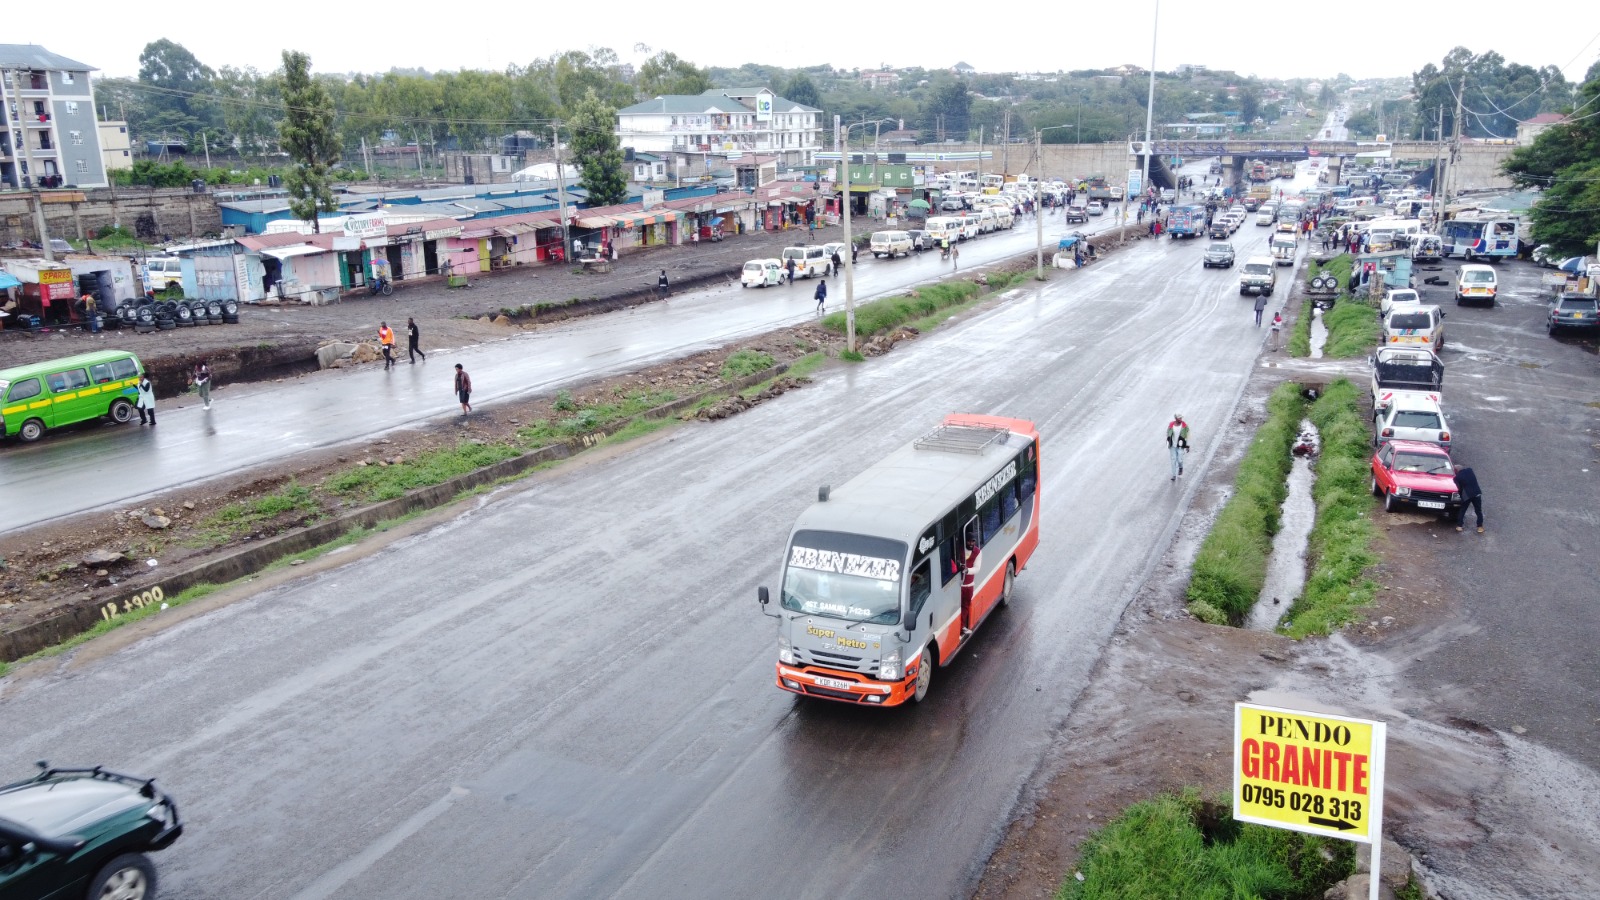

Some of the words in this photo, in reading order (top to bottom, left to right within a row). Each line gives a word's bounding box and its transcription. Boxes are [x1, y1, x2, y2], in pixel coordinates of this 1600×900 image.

[43, 271, 71, 280] SPARES
[975, 460, 1017, 510] EBENEZER
[788, 545, 901, 581] EBENEZER
[819, 602, 846, 612] SAMUEL
[807, 625, 835, 639] Super
[836, 636, 867, 650] Metro
[1258, 714, 1351, 746] PENDO
[1242, 737, 1368, 795] GRANITE
[1242, 783, 1285, 808] 0795
[1290, 791, 1324, 815] 028
[1329, 797, 1362, 821] 313
